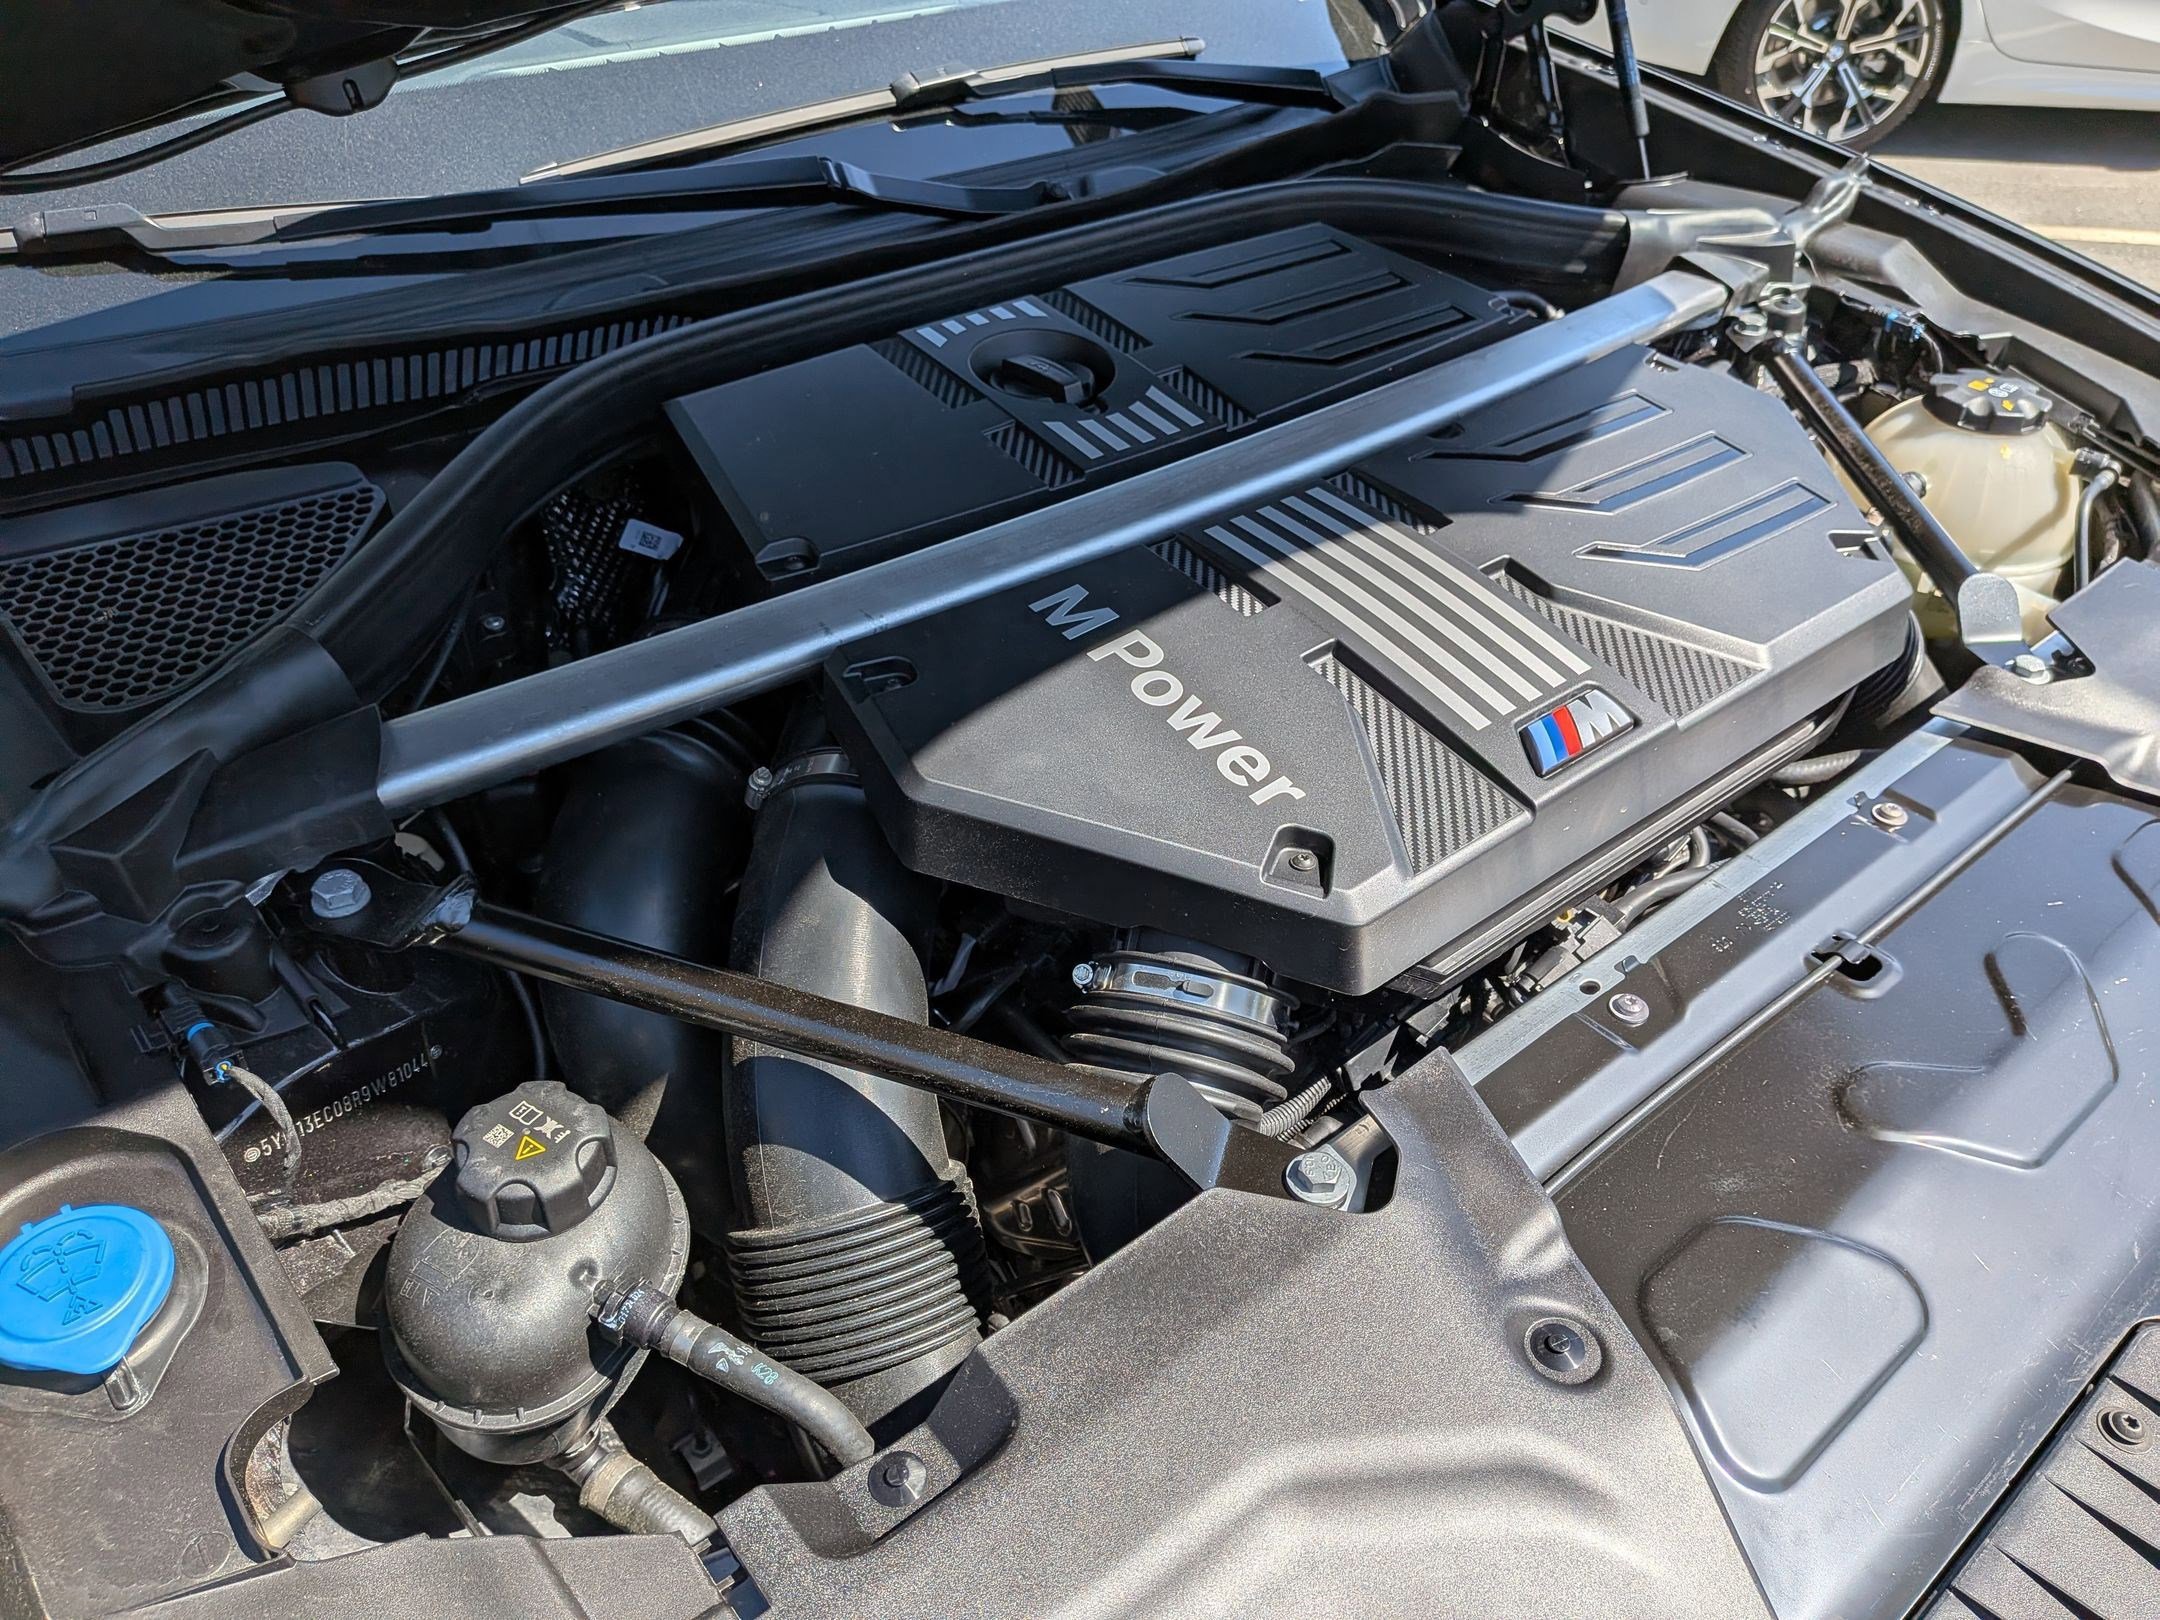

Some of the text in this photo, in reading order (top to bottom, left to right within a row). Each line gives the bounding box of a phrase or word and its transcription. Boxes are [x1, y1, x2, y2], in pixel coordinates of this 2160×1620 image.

[1028, 583, 1307, 806] M Power
[260, 1052, 429, 1156] 5Y13EC08R9W81044
